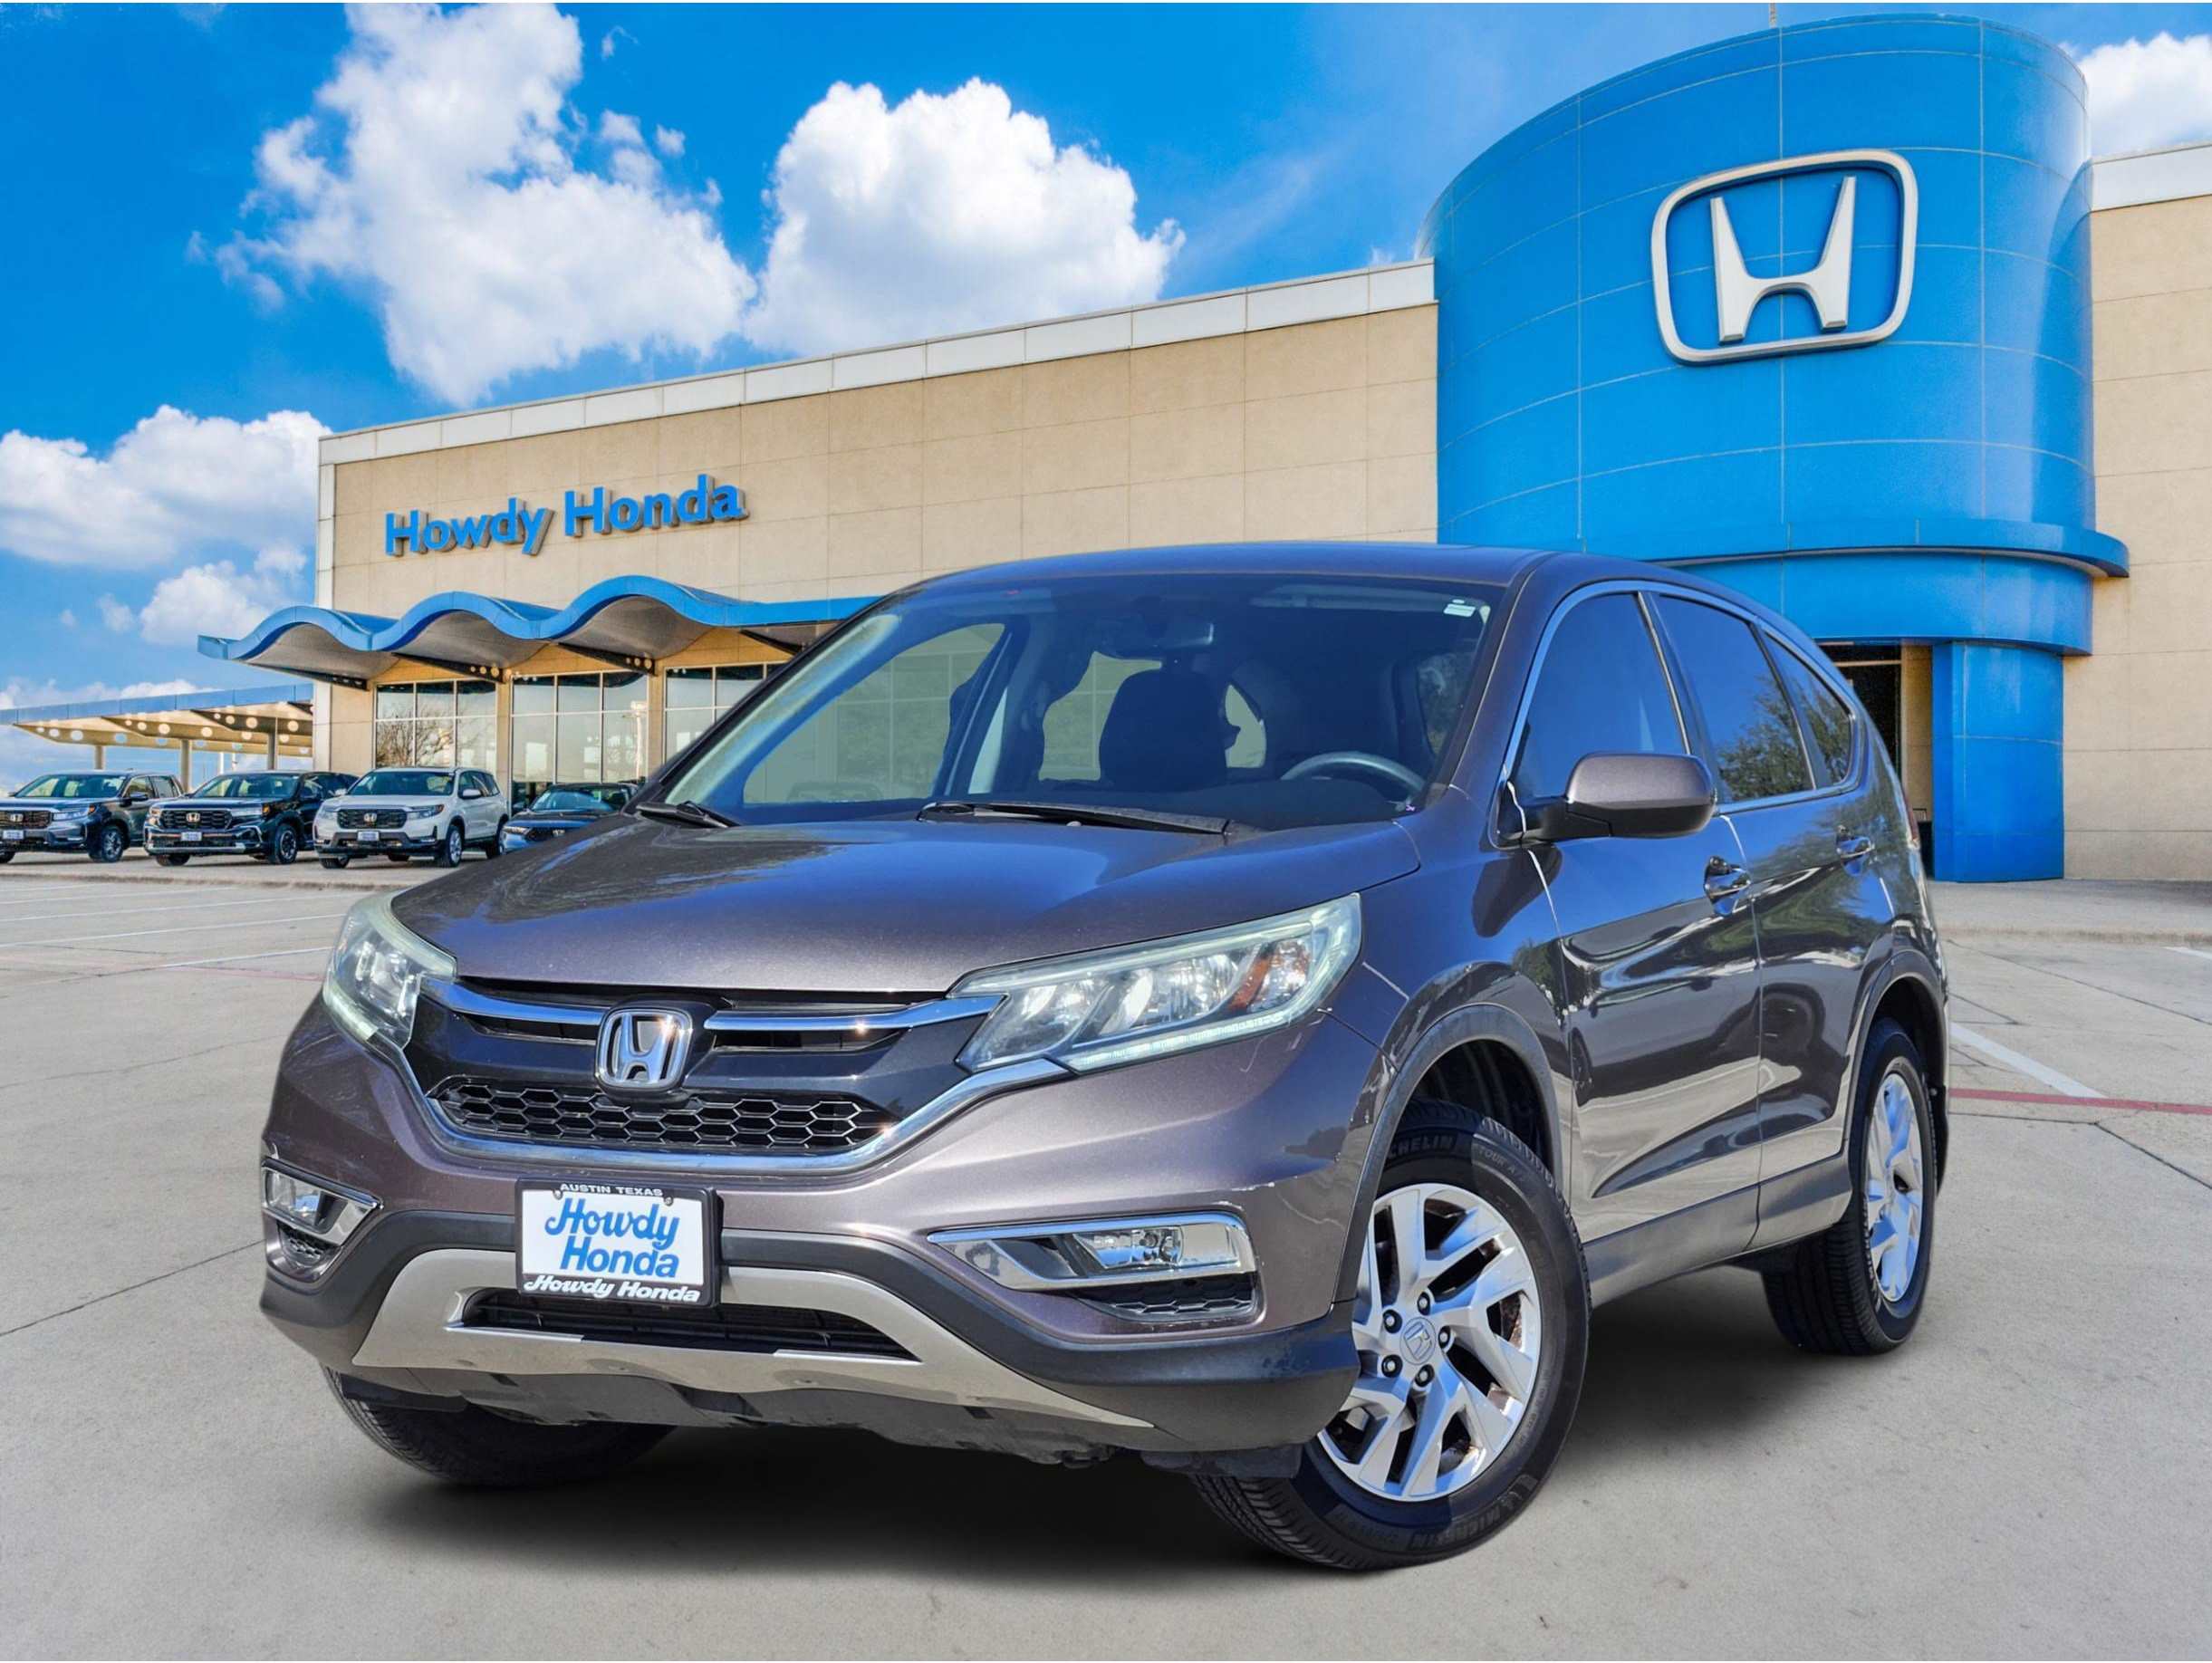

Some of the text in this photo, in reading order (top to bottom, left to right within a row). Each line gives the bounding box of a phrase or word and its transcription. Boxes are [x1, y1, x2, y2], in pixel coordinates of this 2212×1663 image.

[385, 474, 748, 555] Howdy Honda
[1388, 1134, 1454, 1159] CHELIN
[560, 1183, 663, 1197] AUSTIN TEXAS
[544, 1197, 680, 1250] Howdy
[560, 1235, 679, 1278] Honda
[524, 1274, 701, 1303] Howdy Honda
